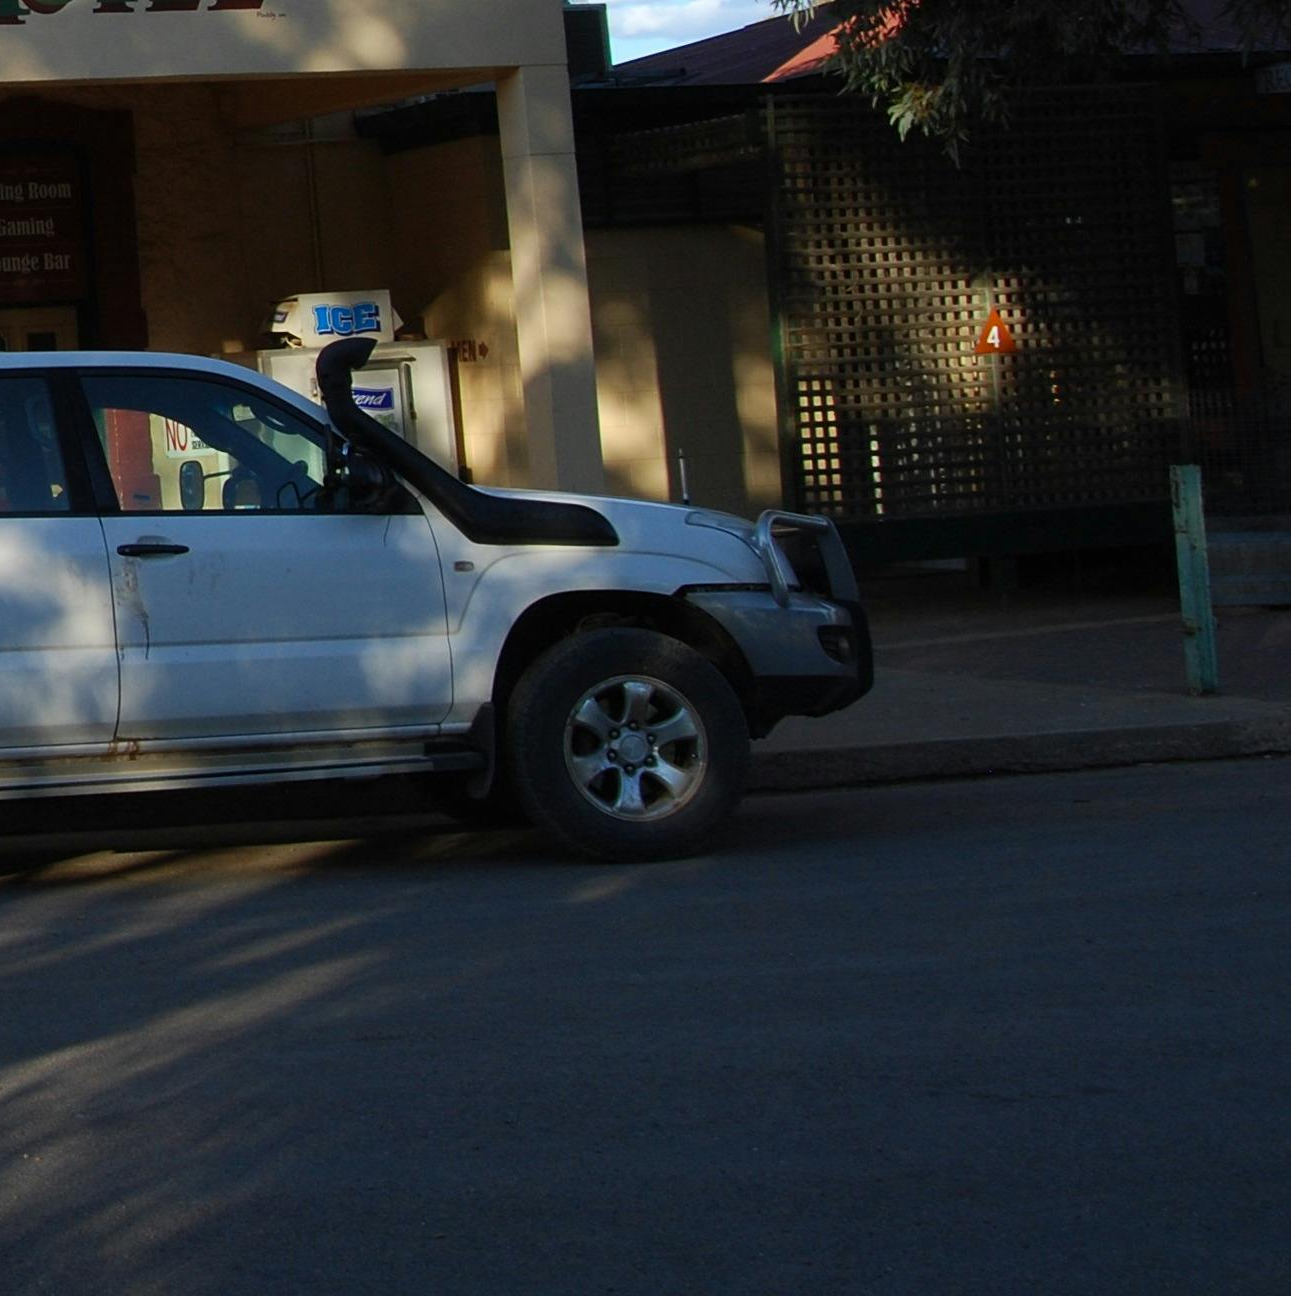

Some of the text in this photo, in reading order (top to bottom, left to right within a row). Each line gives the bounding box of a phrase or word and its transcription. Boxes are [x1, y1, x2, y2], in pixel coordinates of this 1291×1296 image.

[28, 182, 72, 200] Room
[44, 253, 72, 271] Bar
[312, 301, 382, 337] ICE
[986, 324, 1001, 349] 4
